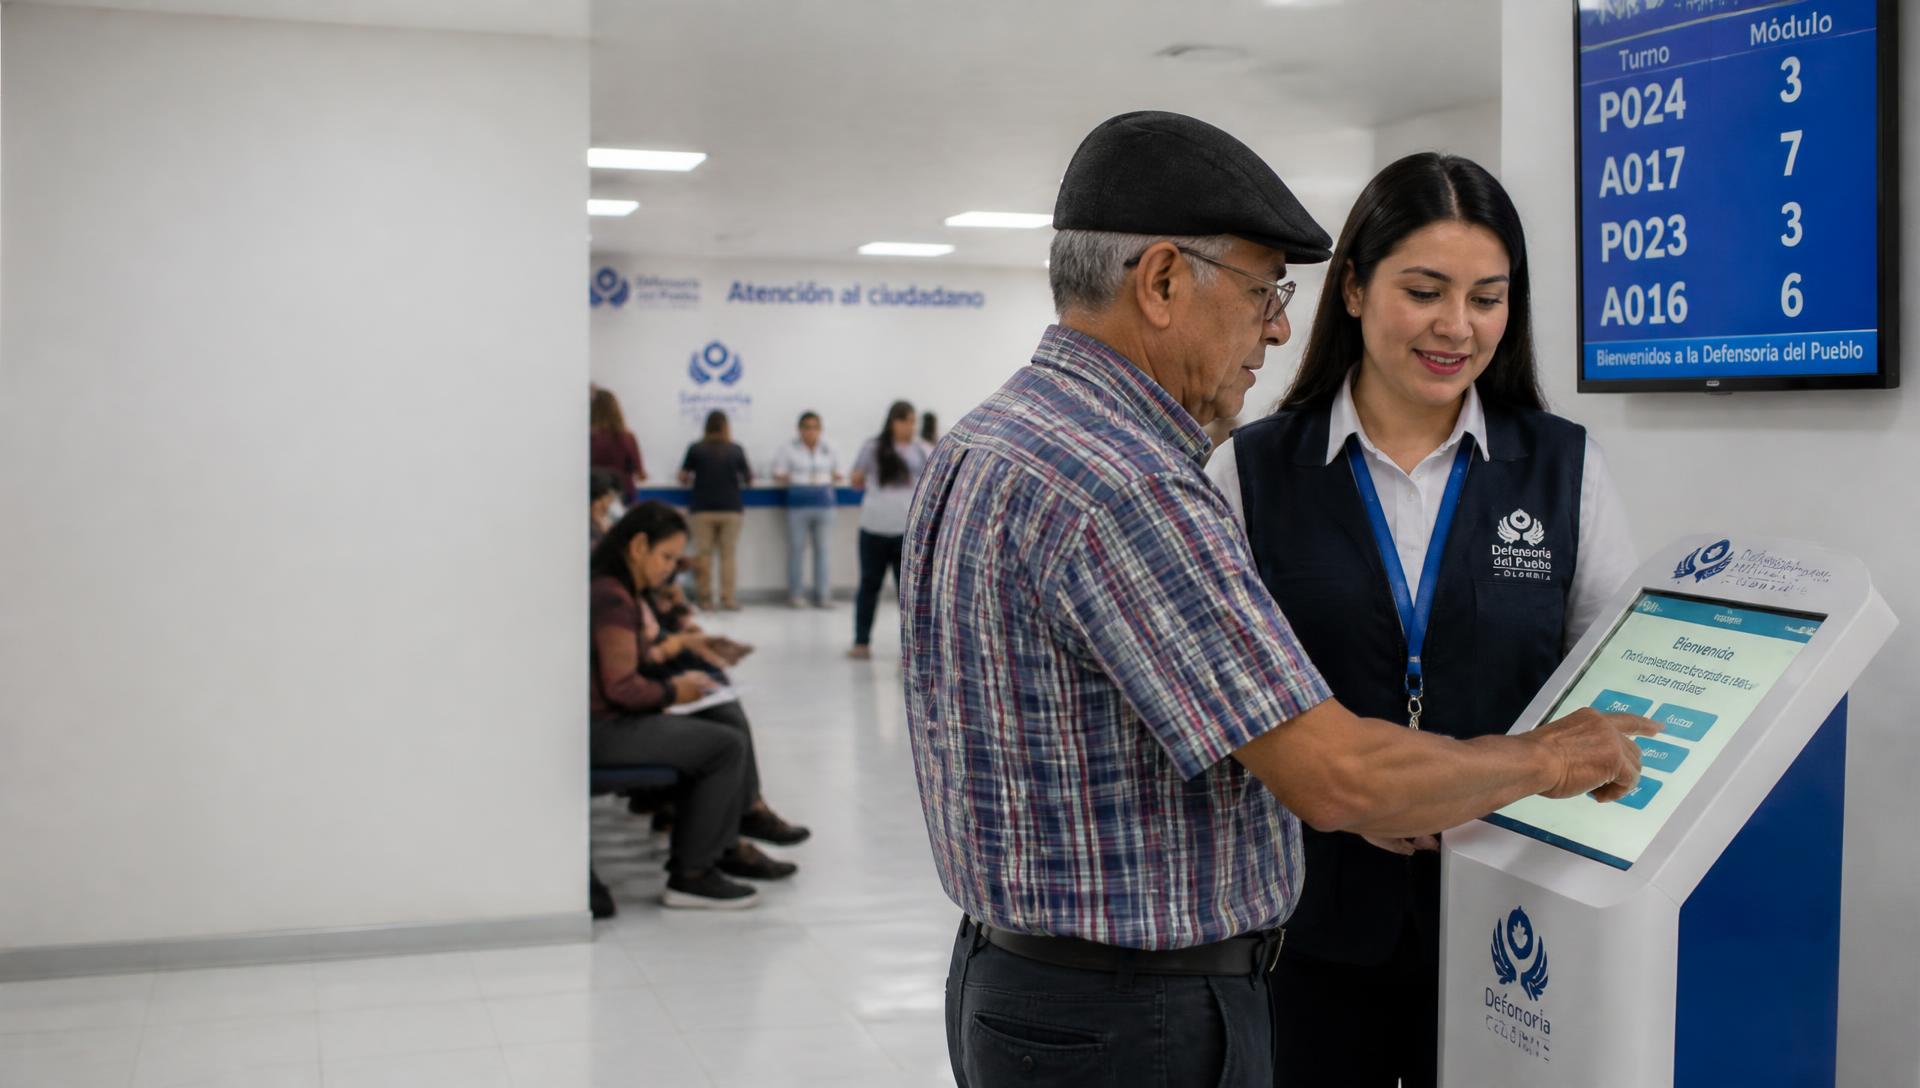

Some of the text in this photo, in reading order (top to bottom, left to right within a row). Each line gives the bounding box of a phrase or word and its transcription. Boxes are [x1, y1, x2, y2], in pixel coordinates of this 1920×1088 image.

[1618, 11, 1833, 72] Turno Módulo
[1599, 56, 1802, 133] P024 3
[1598, 129, 1803, 198] A017 7
[1601, 201, 1803, 263] P023 3
[727, 280, 834, 305] Atención
[841, 284, 860, 306] al
[868, 285, 986, 309] ciudadano
[1600, 272, 1804, 327] A016 6
[1596, 349, 1671, 367] Bienvenidos
[1674, 351, 1684, 365] a
[1686, 348, 1699, 364] la
[1783, 342, 1806, 361] del
[1810, 340, 1864, 360] Pueblo
